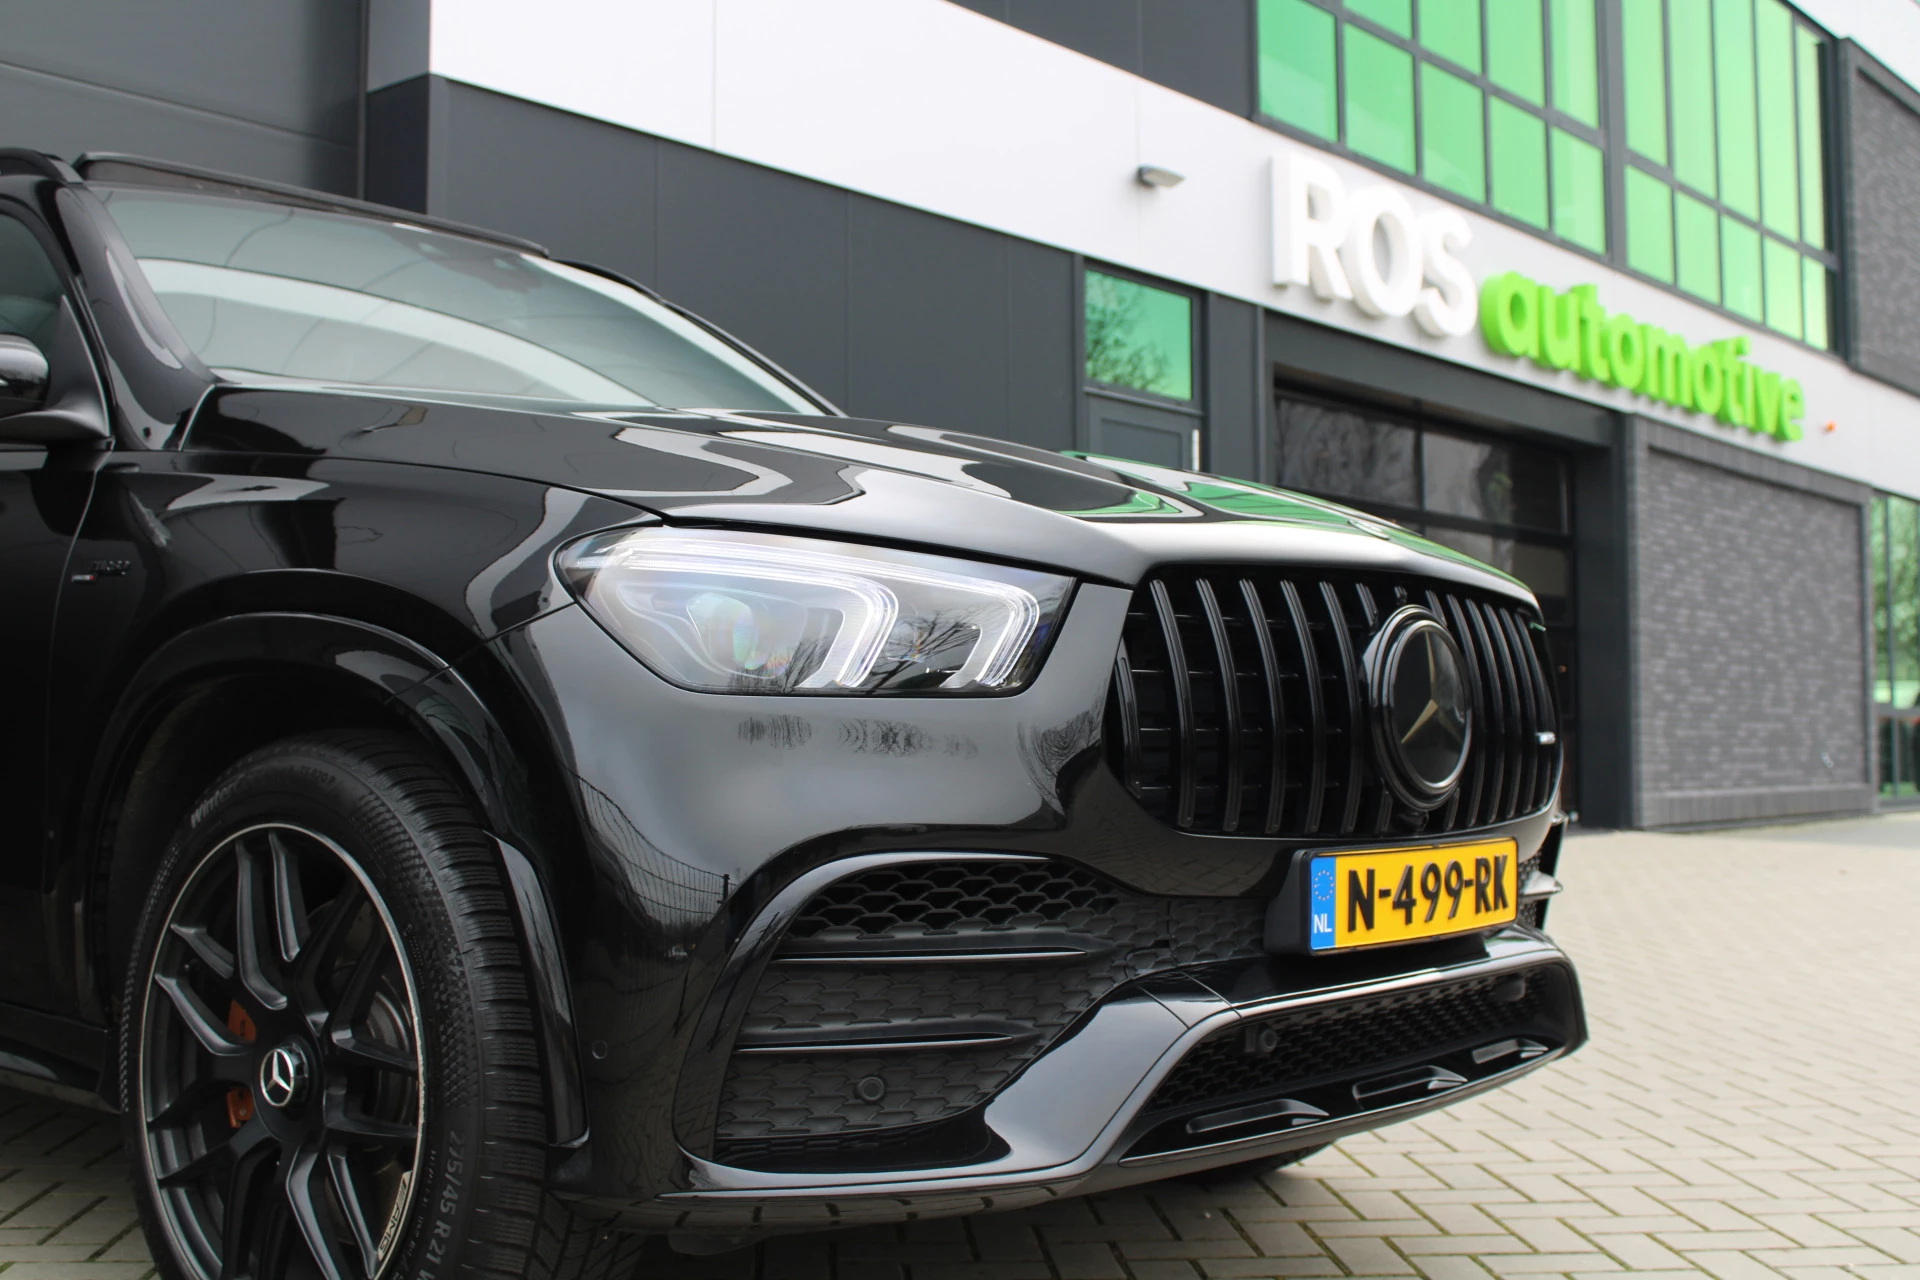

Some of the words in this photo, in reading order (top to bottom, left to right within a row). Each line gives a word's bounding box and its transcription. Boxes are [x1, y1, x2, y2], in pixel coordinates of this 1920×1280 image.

[1272, 150, 1478, 337] ROS
[1481, 271, 1803, 442] automotive
[1313, 913, 1332, 934] NL
[1347, 854, 1509, 933] N-499-RK
[439, 1130, 466, 1216] 275/45
